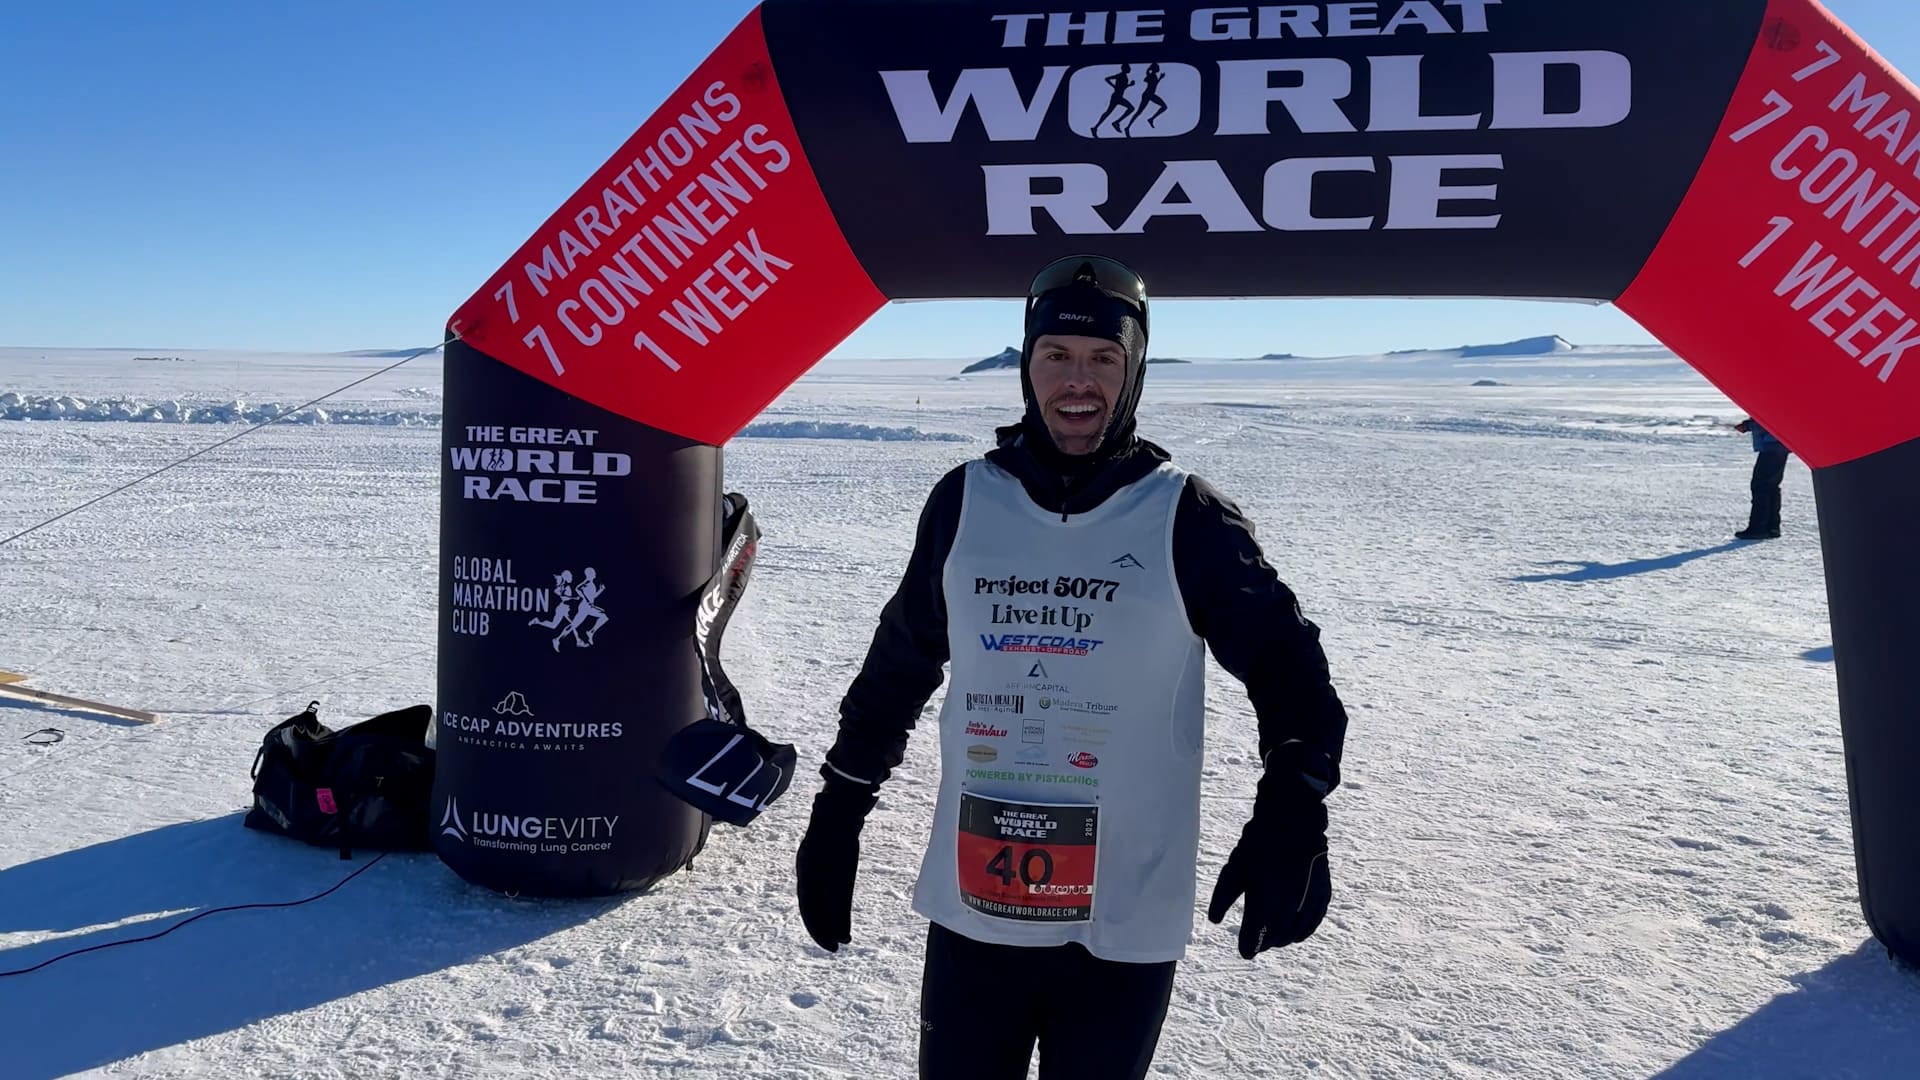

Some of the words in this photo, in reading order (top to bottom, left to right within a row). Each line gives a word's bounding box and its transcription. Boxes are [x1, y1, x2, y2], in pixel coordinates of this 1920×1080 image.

[990, 10, 1166, 48] THE
[1189, 0, 1505, 42] GREAT
[1791, 39, 1842, 82] 7
[878, 50, 1632, 144] WORLD
[1729, 89, 1793, 143] 7
[494, 281, 521, 324] 7
[523, 80, 742, 298] MARATHONS
[979, 154, 1505, 236] RACE
[521, 324, 566, 377] 7
[556, 123, 791, 347] CONTINENTS
[633, 330, 682, 373] 1
[658, 227, 795, 348] WEEK
[1737, 215, 1794, 269] 1
[1772, 240, 1920, 384] WEEK
[1058, 312, 1088, 322] CRAFT
[465, 425, 505, 443] THE
[509, 426, 599, 446] GREAT
[450, 447, 632, 477] WORLD
[463, 475, 598, 505] RACE
[453, 555, 517, 584] GLOBAL
[453, 582, 550, 613] MARATHON
[973, 575, 1050, 597] Project
[1053, 575, 1120, 603] 5077
[452, 608, 490, 636] CLUB
[991, 603, 1038, 625] Live
[1040, 605, 1057, 626] it
[1061, 605, 1093, 633] Up
[1086, 701, 1119, 712] Tribune
[443, 711, 459, 729] ICE
[460, 715, 490, 734] CAP
[494, 720, 623, 739] ADVENTURES
[458, 735, 526, 750] ANTARCTICA
[532, 743, 585, 751] AWAITS
[965, 768, 1015, 781] POWERED
[1017, 772, 1033, 782] BY
[1035, 773, 1099, 788] PISTACHIOS
[472, 811, 620, 839] LUNGEVITY
[992, 815, 1058, 830] WORLD
[1002, 809, 1019, 819] THE
[1019, 811, 1049, 821] GREAT
[1085, 817, 1094, 837] 2025
[473, 836, 537, 854] Transforming
[540, 842, 567, 854] Lung
[570, 841, 612, 852] Cancer
[1000, 826, 1048, 839] RACE
[985, 845, 1054, 888] 40
[967, 895, 1078, 917] WWW.THEGREATWORLDRACE.COM
